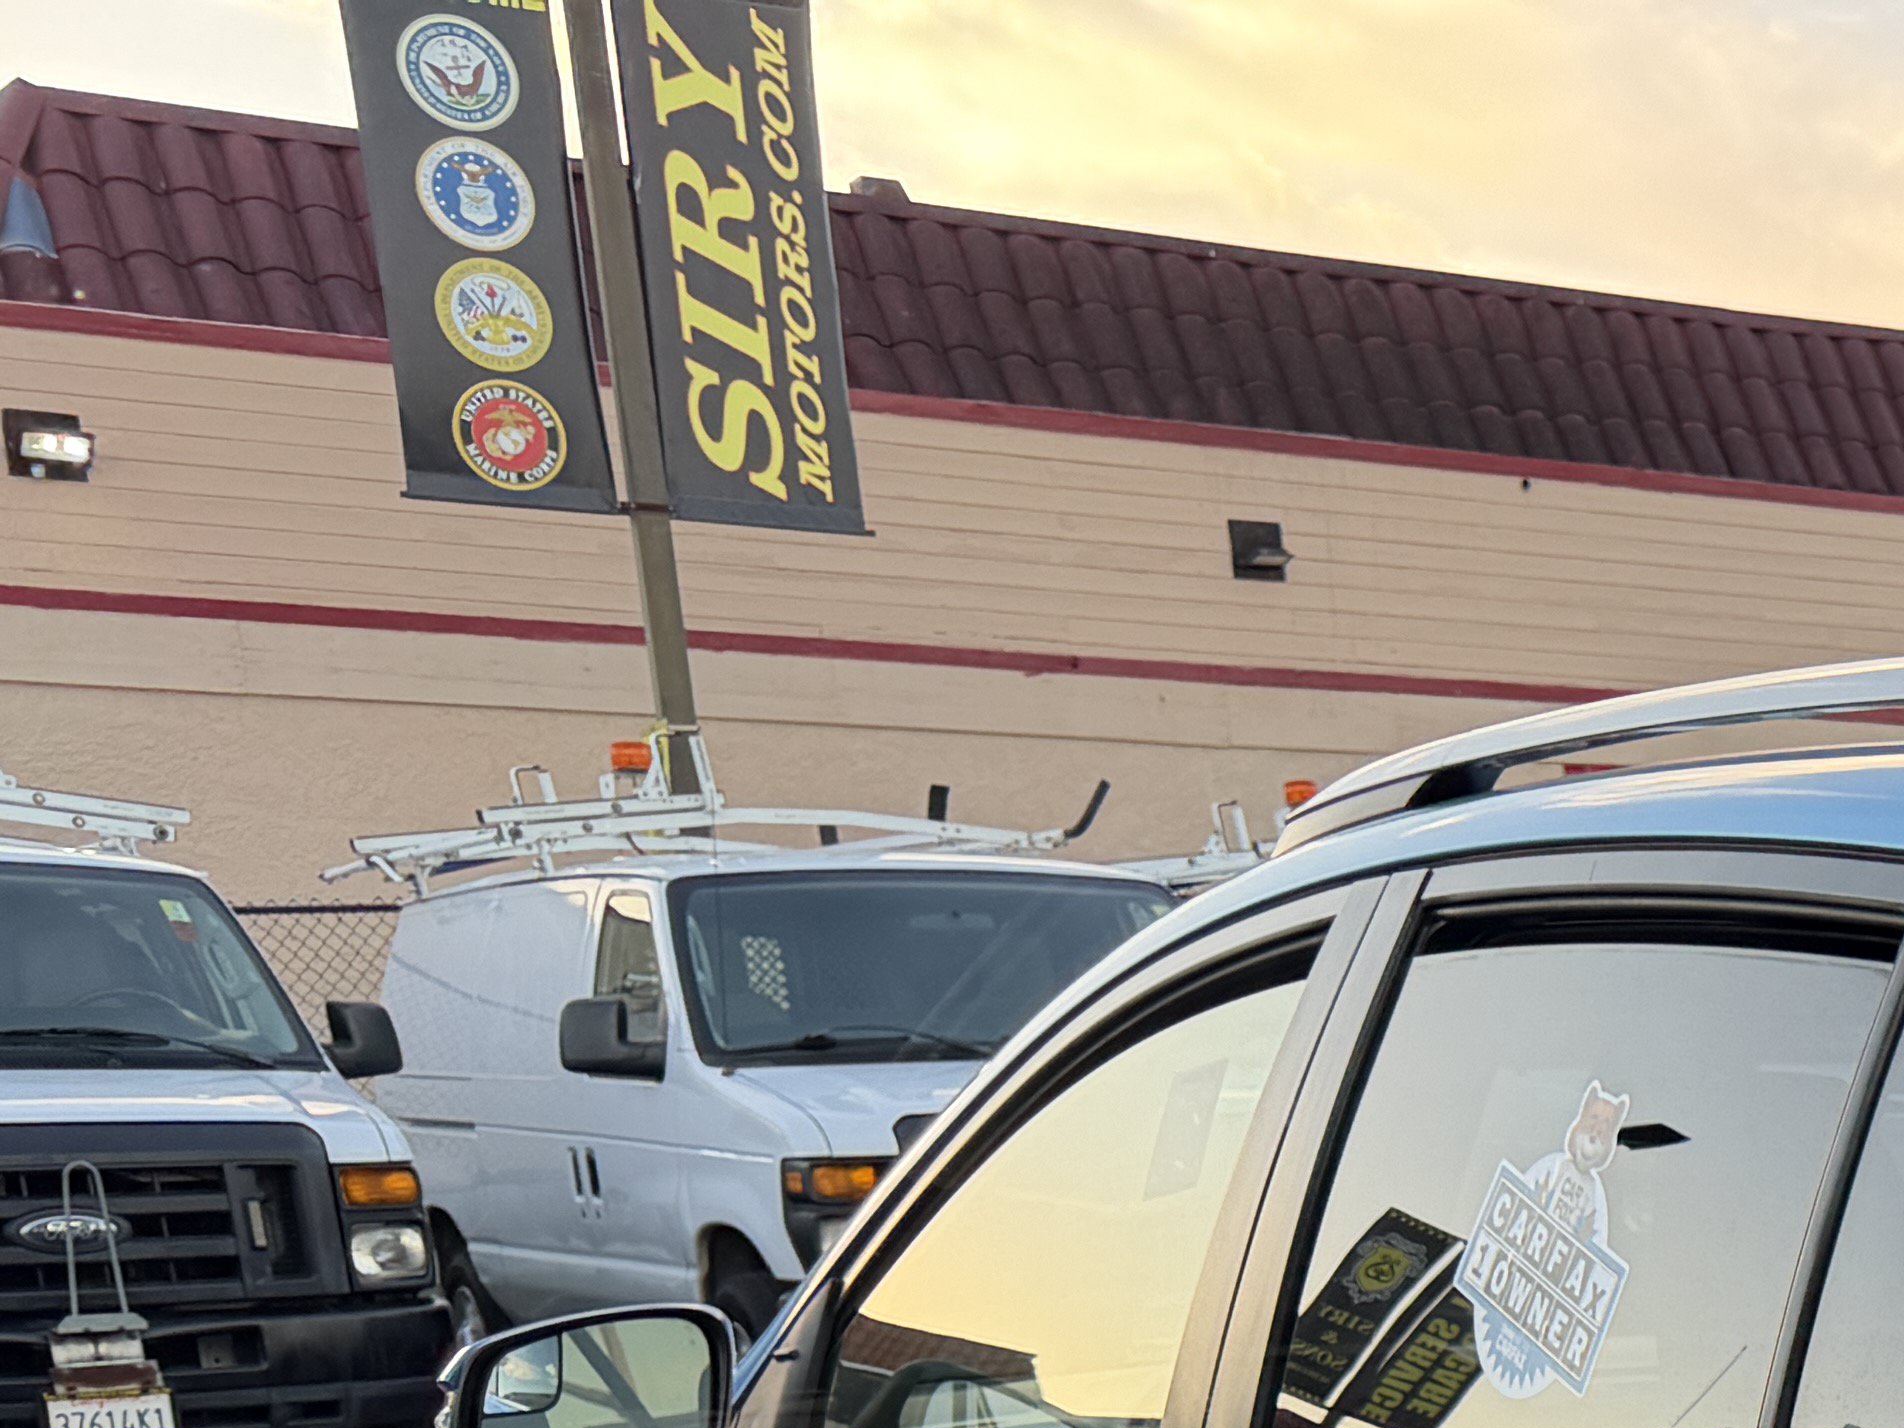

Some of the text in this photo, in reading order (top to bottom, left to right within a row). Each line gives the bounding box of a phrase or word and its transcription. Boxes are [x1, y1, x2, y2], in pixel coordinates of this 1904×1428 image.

[645, 0, 788, 502] SIRY
[749, 7, 834, 503] MOTORS.COM
[461, 387, 554, 428] UNITED STATES
[467, 443, 557, 483] MARINE CORPS
[1471, 1243, 1490, 1281] 1
[1490, 1260, 1588, 1369] OWNER
[1492, 1193, 1606, 1319] CARFAX
